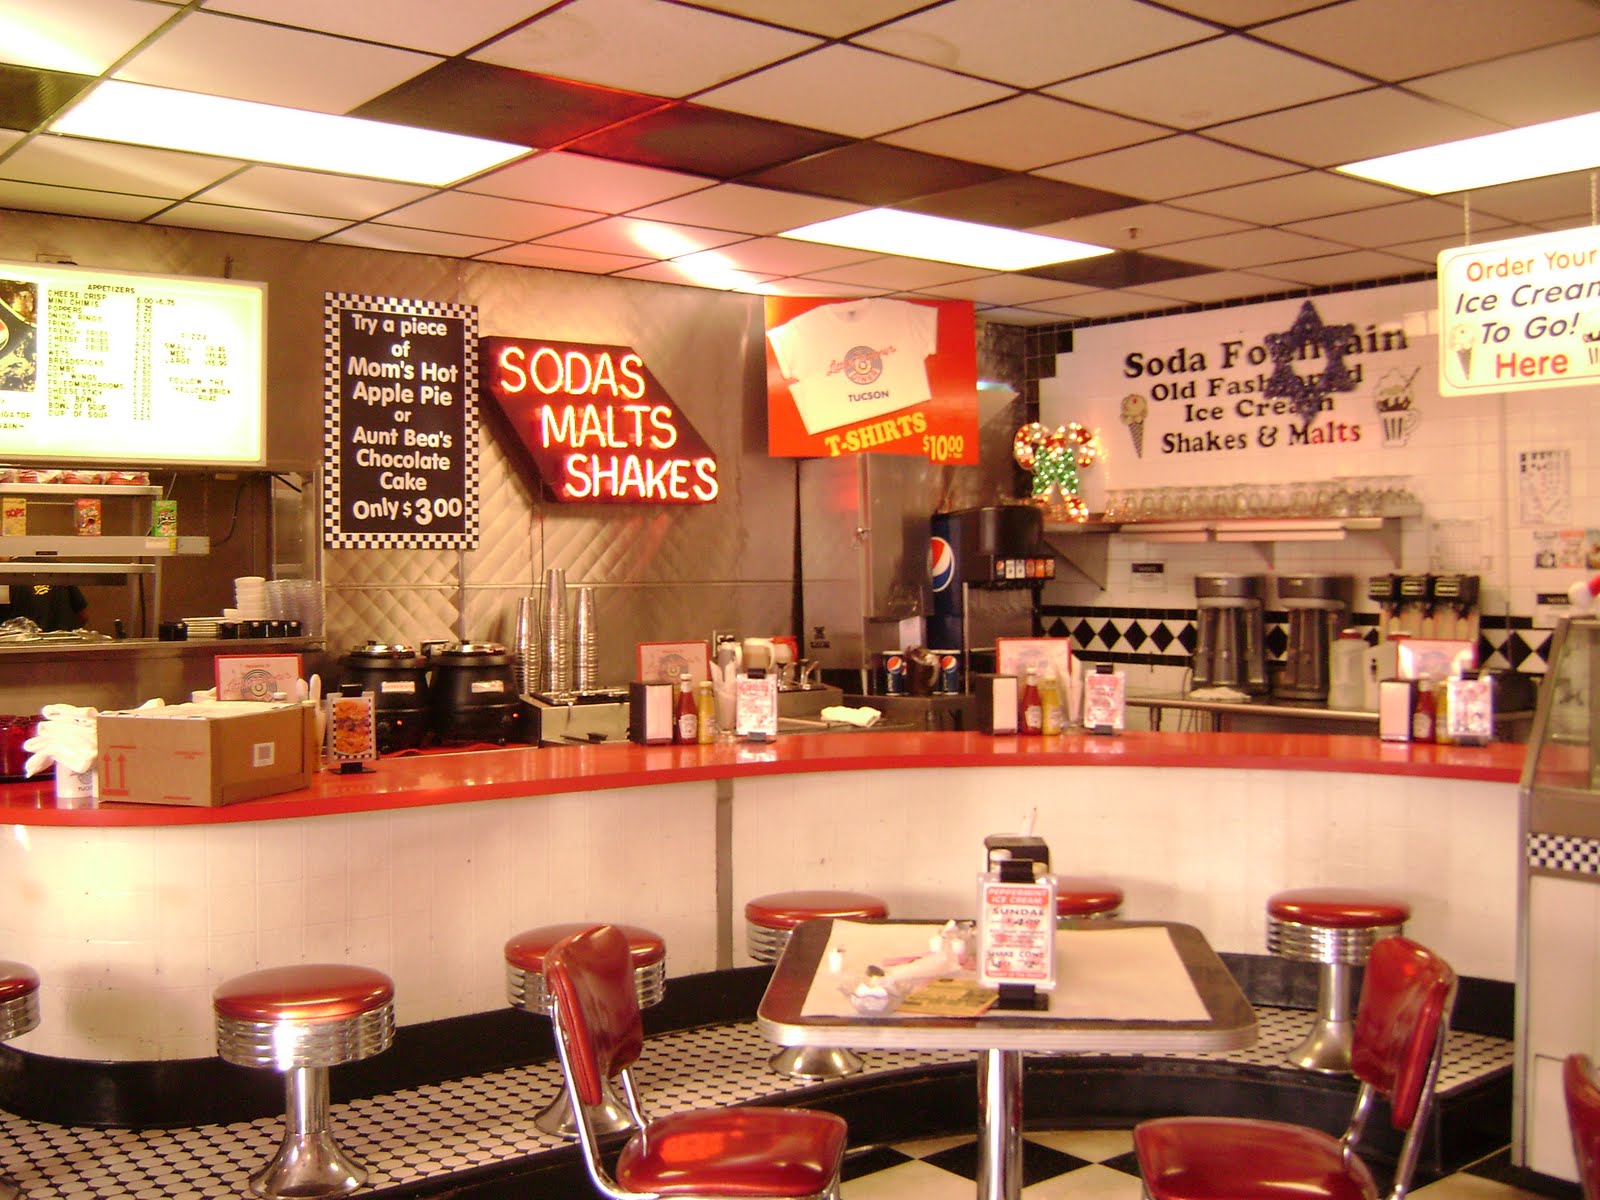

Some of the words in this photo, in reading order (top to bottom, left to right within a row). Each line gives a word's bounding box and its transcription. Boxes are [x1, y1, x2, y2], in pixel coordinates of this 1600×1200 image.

[1466, 256, 1534, 282] Order
[1544, 249, 1597, 270] Your
[48, 289, 80, 299] CHEESE
[84, 292, 107, 301] CRISP
[87, 284, 135, 295] APPETIZERS
[48, 304, 82, 314] POPPERS
[1455, 293, 1498, 315] Ice
[48, 312, 72, 320] ONION
[78, 314, 103, 322] RINGS
[351, 313, 378, 335] Try
[382, 319, 395, 333] a
[400, 317, 448, 338] piece
[1481, 322, 1510, 344] To
[1524, 312, 1580, 340] Go!
[391, 340, 411, 358] of
[347, 356, 415, 381] Mom's
[421, 361, 459, 383] Hot
[500, 346, 645, 400] SODAS
[1123, 347, 1207, 378] Soda
[1495, 352, 1568, 379] Here
[352, 380, 415, 407] Apple
[420, 385, 453, 407] Pie
[848, 390, 889, 403] TUCSON
[1151, 379, 1196, 402] Old
[394, 410, 412, 423] or
[1184, 404, 1224, 422] Ice
[352, 425, 399, 446] Aunt
[404, 428, 453, 449] Bea's
[541, 403, 678, 449] MALTS
[825, 412, 927, 457] T-SHIRTS
[1161, 431, 1247, 454] Shakes
[1257, 426, 1278, 447] &
[1289, 421, 1361, 446] Malts
[356, 448, 451, 471] Chocolate
[379, 471, 428, 491] Cake
[565, 452, 719, 501] SHAKES
[352, 497, 399, 521] Only
[992, 907, 1045, 916] SUNDAE
[1009, 896, 1043, 904] CREAM
